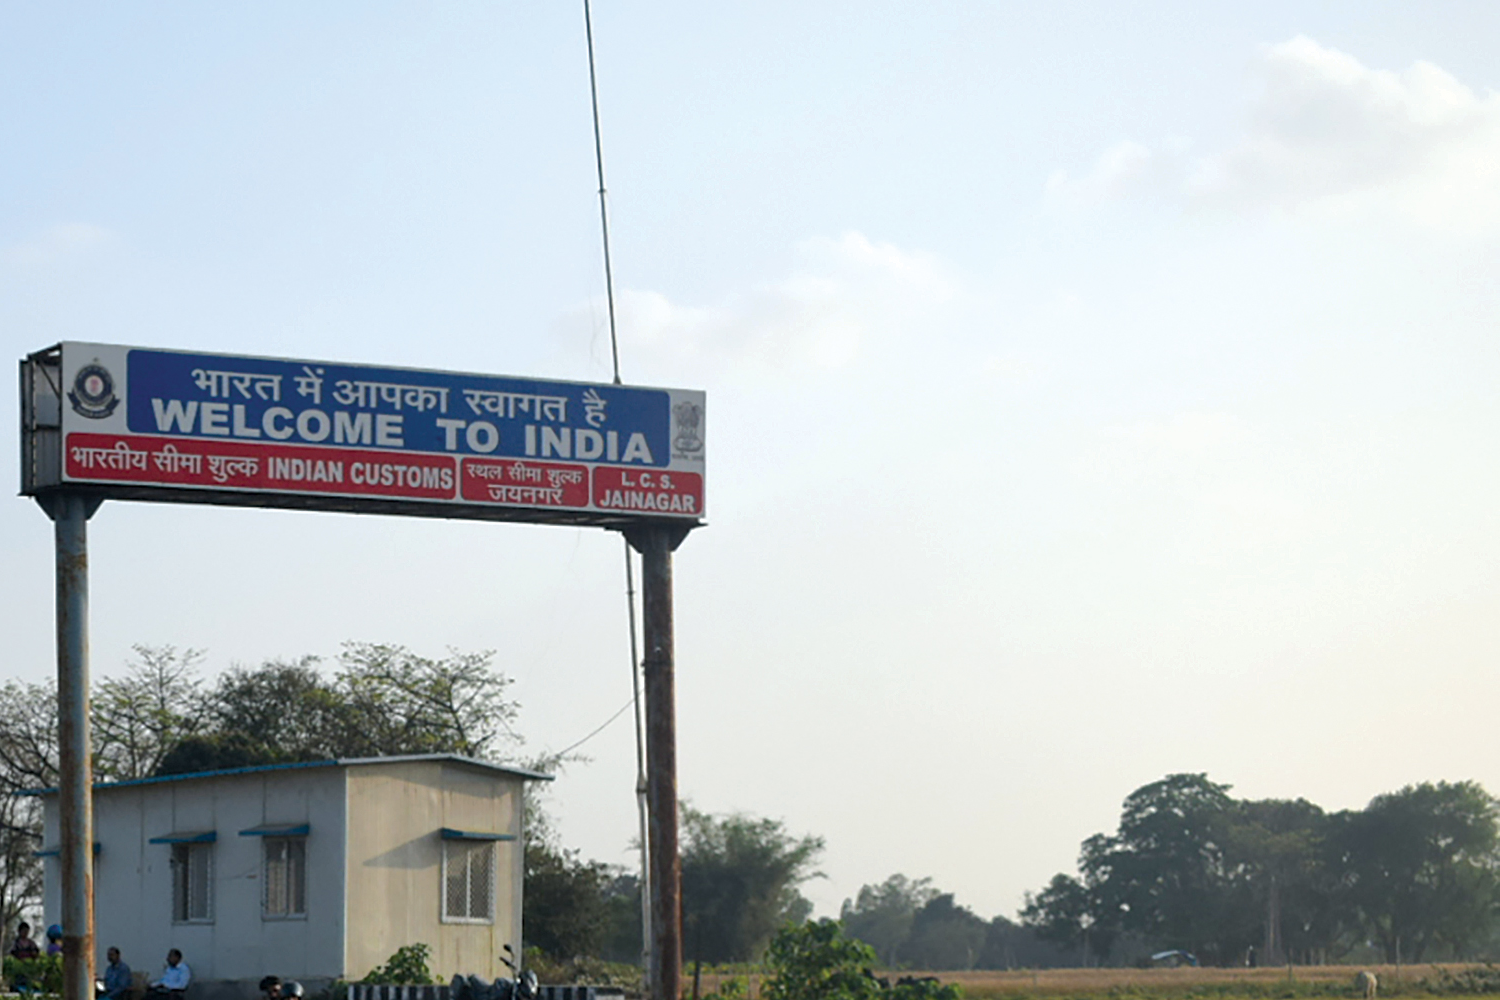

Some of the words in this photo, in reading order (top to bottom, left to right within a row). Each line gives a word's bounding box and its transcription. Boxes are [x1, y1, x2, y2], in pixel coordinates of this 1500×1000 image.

[191, 368, 283, 401] भारत
[293, 366, 325, 405] में
[332, 380, 449, 414] आपका
[462, 388, 568, 423] स्वागत
[582, 387, 607, 428] है
[151, 398, 404, 447] WELCOME
[436, 418, 499, 453] TO
[525, 425, 653, 464] INDIA
[71, 441, 148, 471] भारतीय
[152, 443, 202, 475] सीमा
[207, 454, 259, 483] शुल्क
[268, 456, 344, 483] INDIAN
[351, 462, 453, 490] CUSTOMS
[466, 463, 502, 481] स्थल
[507, 461, 541, 483] सीमा
[547, 467, 583, 489] शुल्क
[488, 483, 563, 505] जयनगर
[600, 489, 695, 513] JAINAGAR
